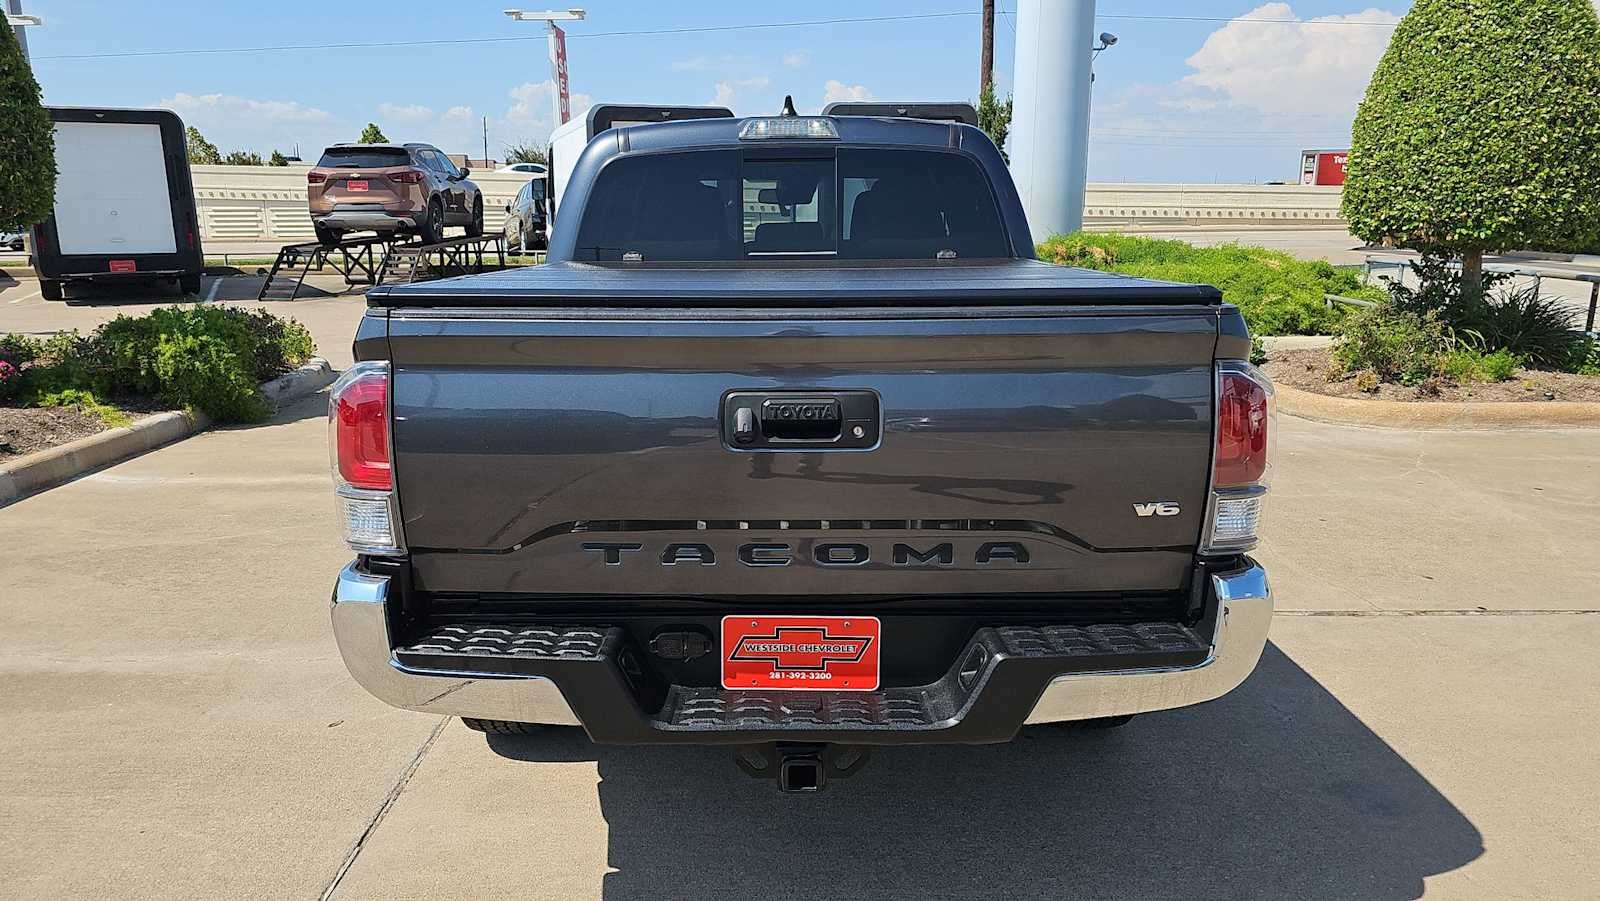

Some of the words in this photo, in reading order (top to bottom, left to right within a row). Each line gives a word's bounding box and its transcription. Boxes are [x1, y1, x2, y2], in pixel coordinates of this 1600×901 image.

[558, 38, 568, 112] USED
[767, 404, 838, 420] TOYOTA
[1132, 501, 1180, 517] V6
[581, 542, 1030, 567] TACOMA
[744, 643, 795, 653] WESTSIDE
[798, 643, 857, 654] CHEVROLET
[769, 671, 832, 680] 281-392-3200
